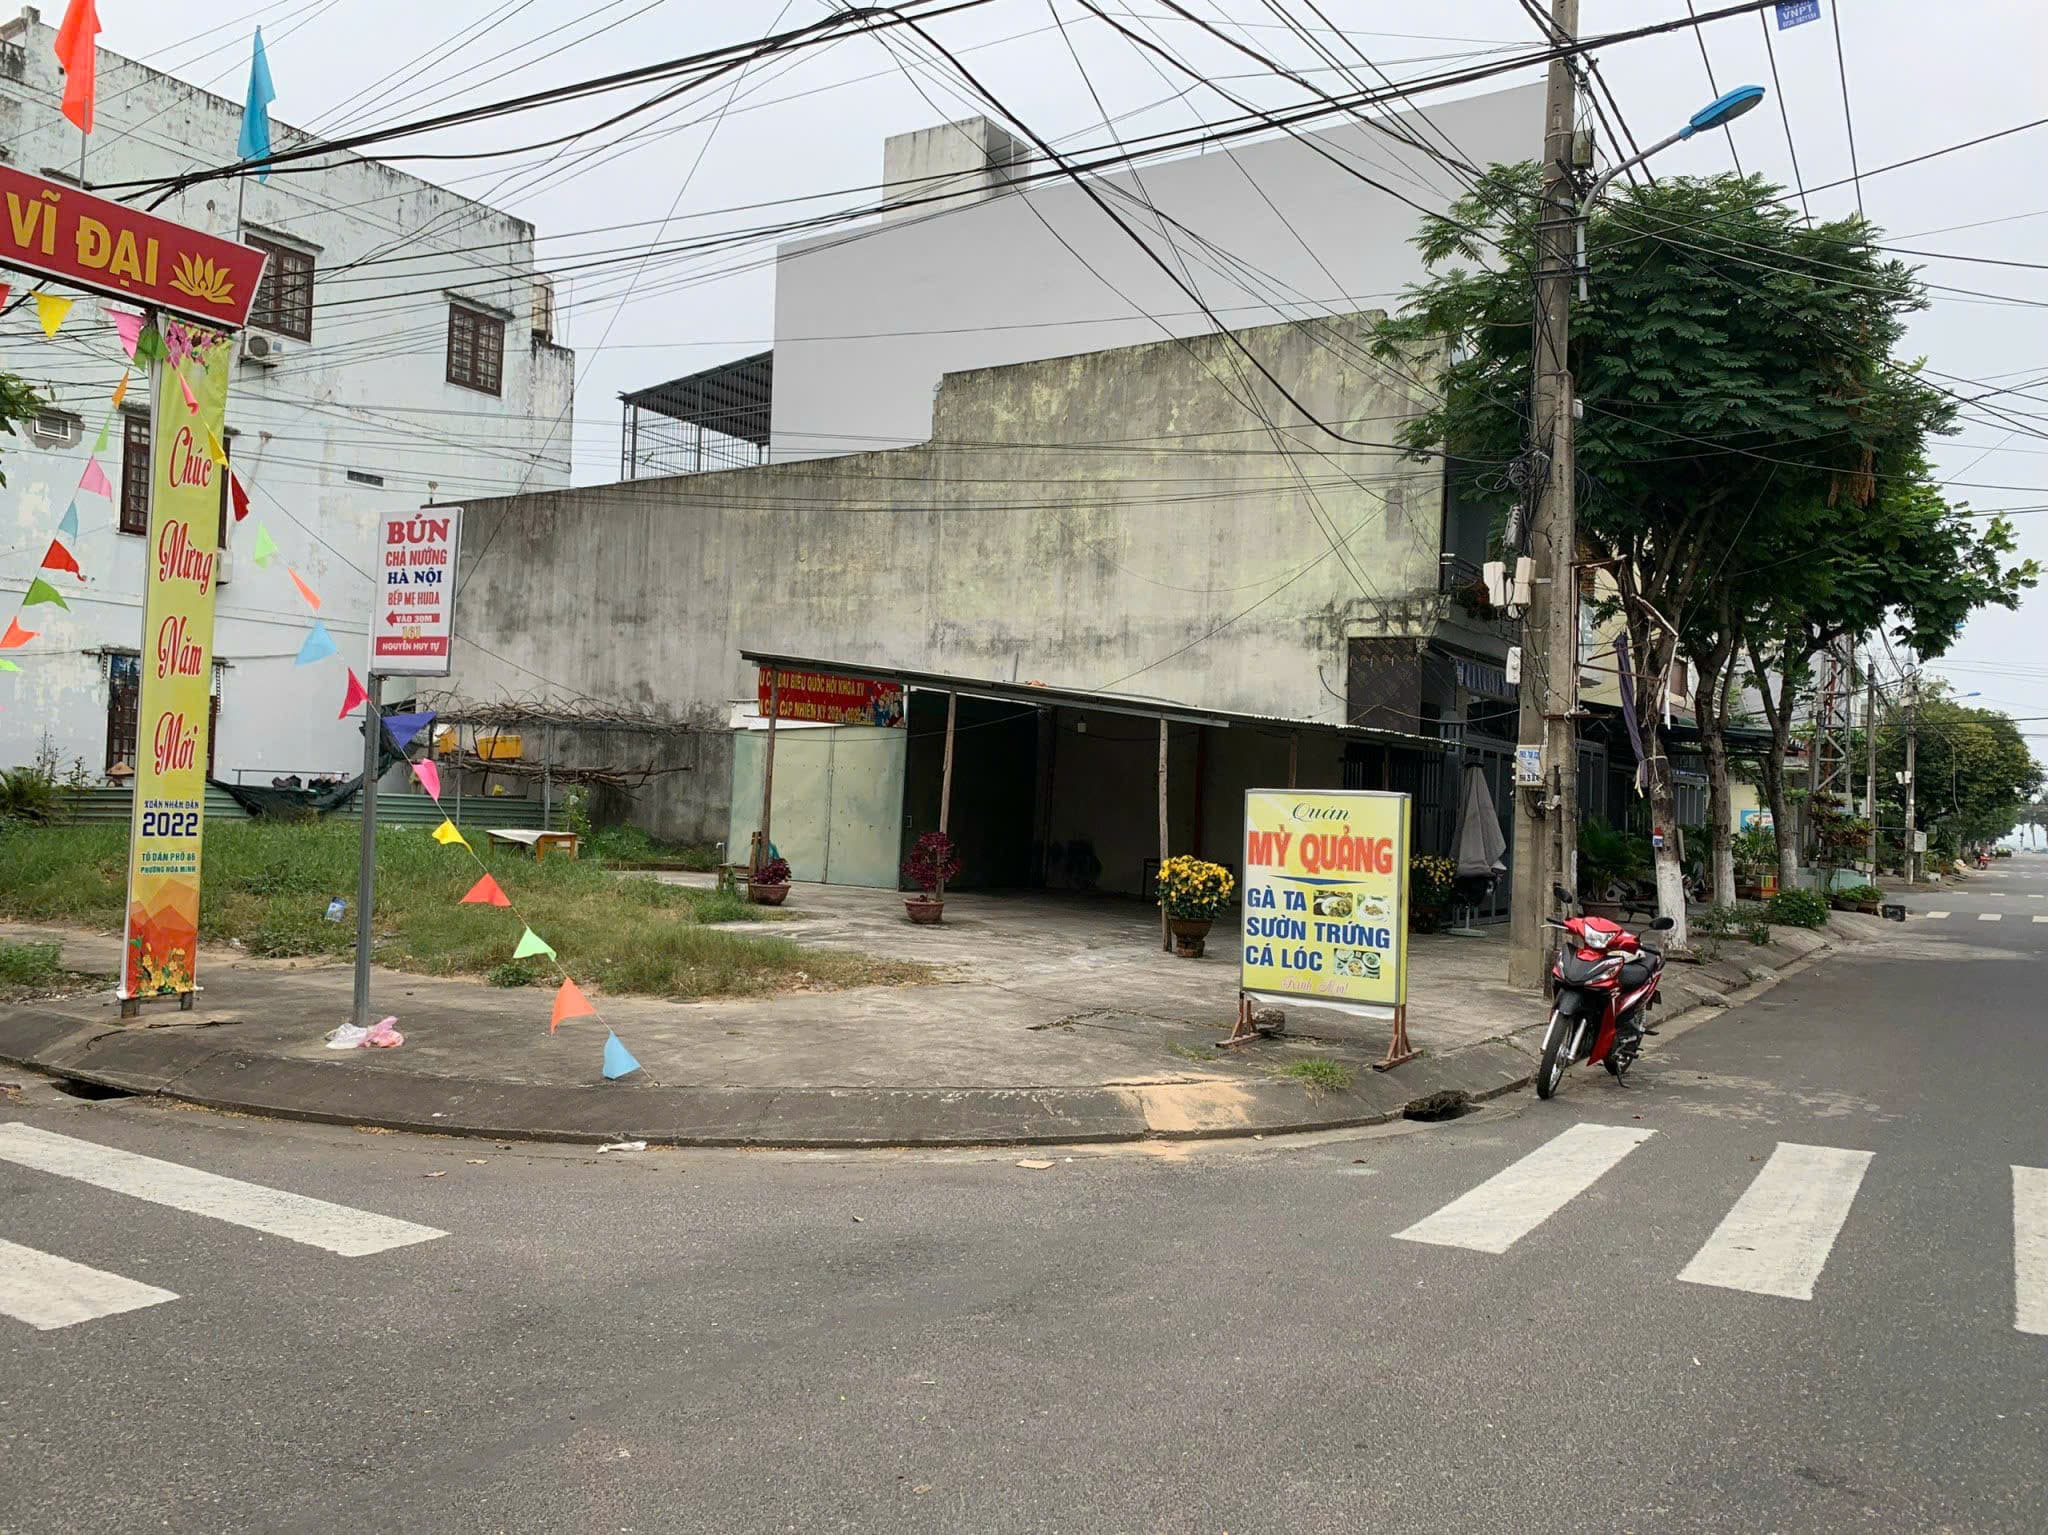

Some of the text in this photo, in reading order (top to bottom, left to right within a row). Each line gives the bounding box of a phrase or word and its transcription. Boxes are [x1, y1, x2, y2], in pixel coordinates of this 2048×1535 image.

[1782, 4, 1813, 20] VNPT
[6, 189, 159, 288] VĨ ĐẠI
[168, 426, 212, 488] Chúc
[387, 513, 450, 544] BÚN
[158, 519, 213, 596] Mừng
[386, 545, 447, 567] CHẢ NƯỚNG
[387, 567, 442, 587] HÀ NỘI
[388, 588, 403, 606] BẾP
[157, 615, 203, 680] Năm
[382, 640, 412, 651] NGUYỄN
[413, 643, 429, 651] HUY
[154, 711, 199, 776] Mới
[142, 811, 199, 837] 2022
[1290, 802, 1350, 822] Quán
[1300, 825, 1393, 875] QUẢNG
[1247, 885, 1307, 911] GÀ TA
[1246, 914, 1390, 949] SƯỜN TRỨNG
[1245, 943, 1323, 971] CÁ LÓC
